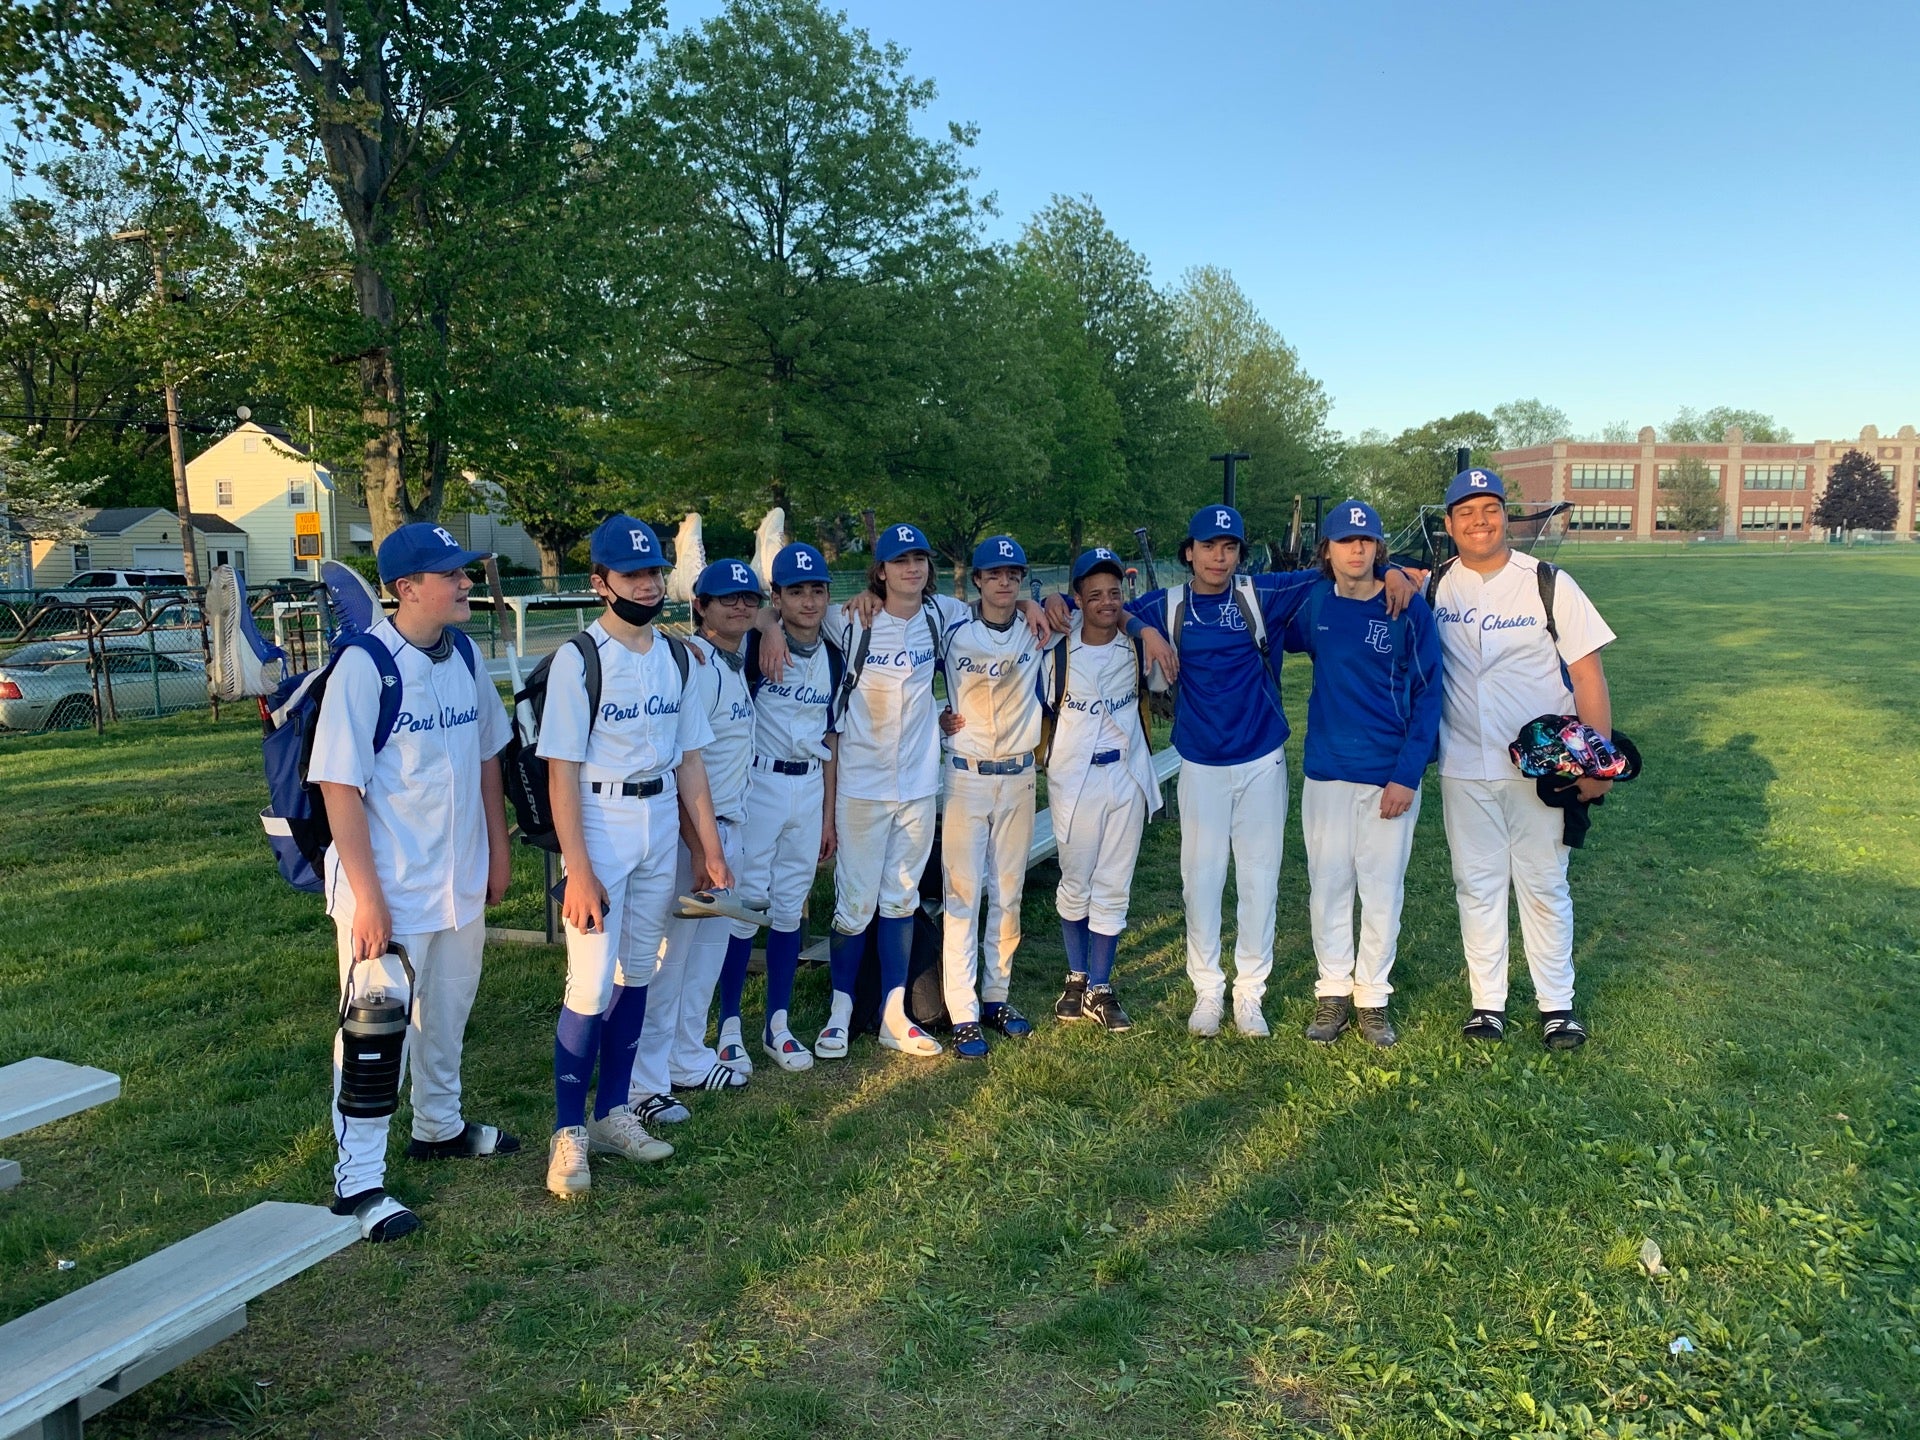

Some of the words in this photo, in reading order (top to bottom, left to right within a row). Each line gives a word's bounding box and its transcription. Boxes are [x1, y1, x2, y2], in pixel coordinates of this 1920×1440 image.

[299, 524, 317, 533] SPEED
[300, 514, 316, 524] YOUR
[1436, 607, 1461, 623] Port
[1481, 614, 1537, 631] Chester
[956, 656, 987, 674] Port
[601, 702, 640, 722] Port
[391, 711, 435, 734] Port
[518, 761, 541, 825] EASTON
